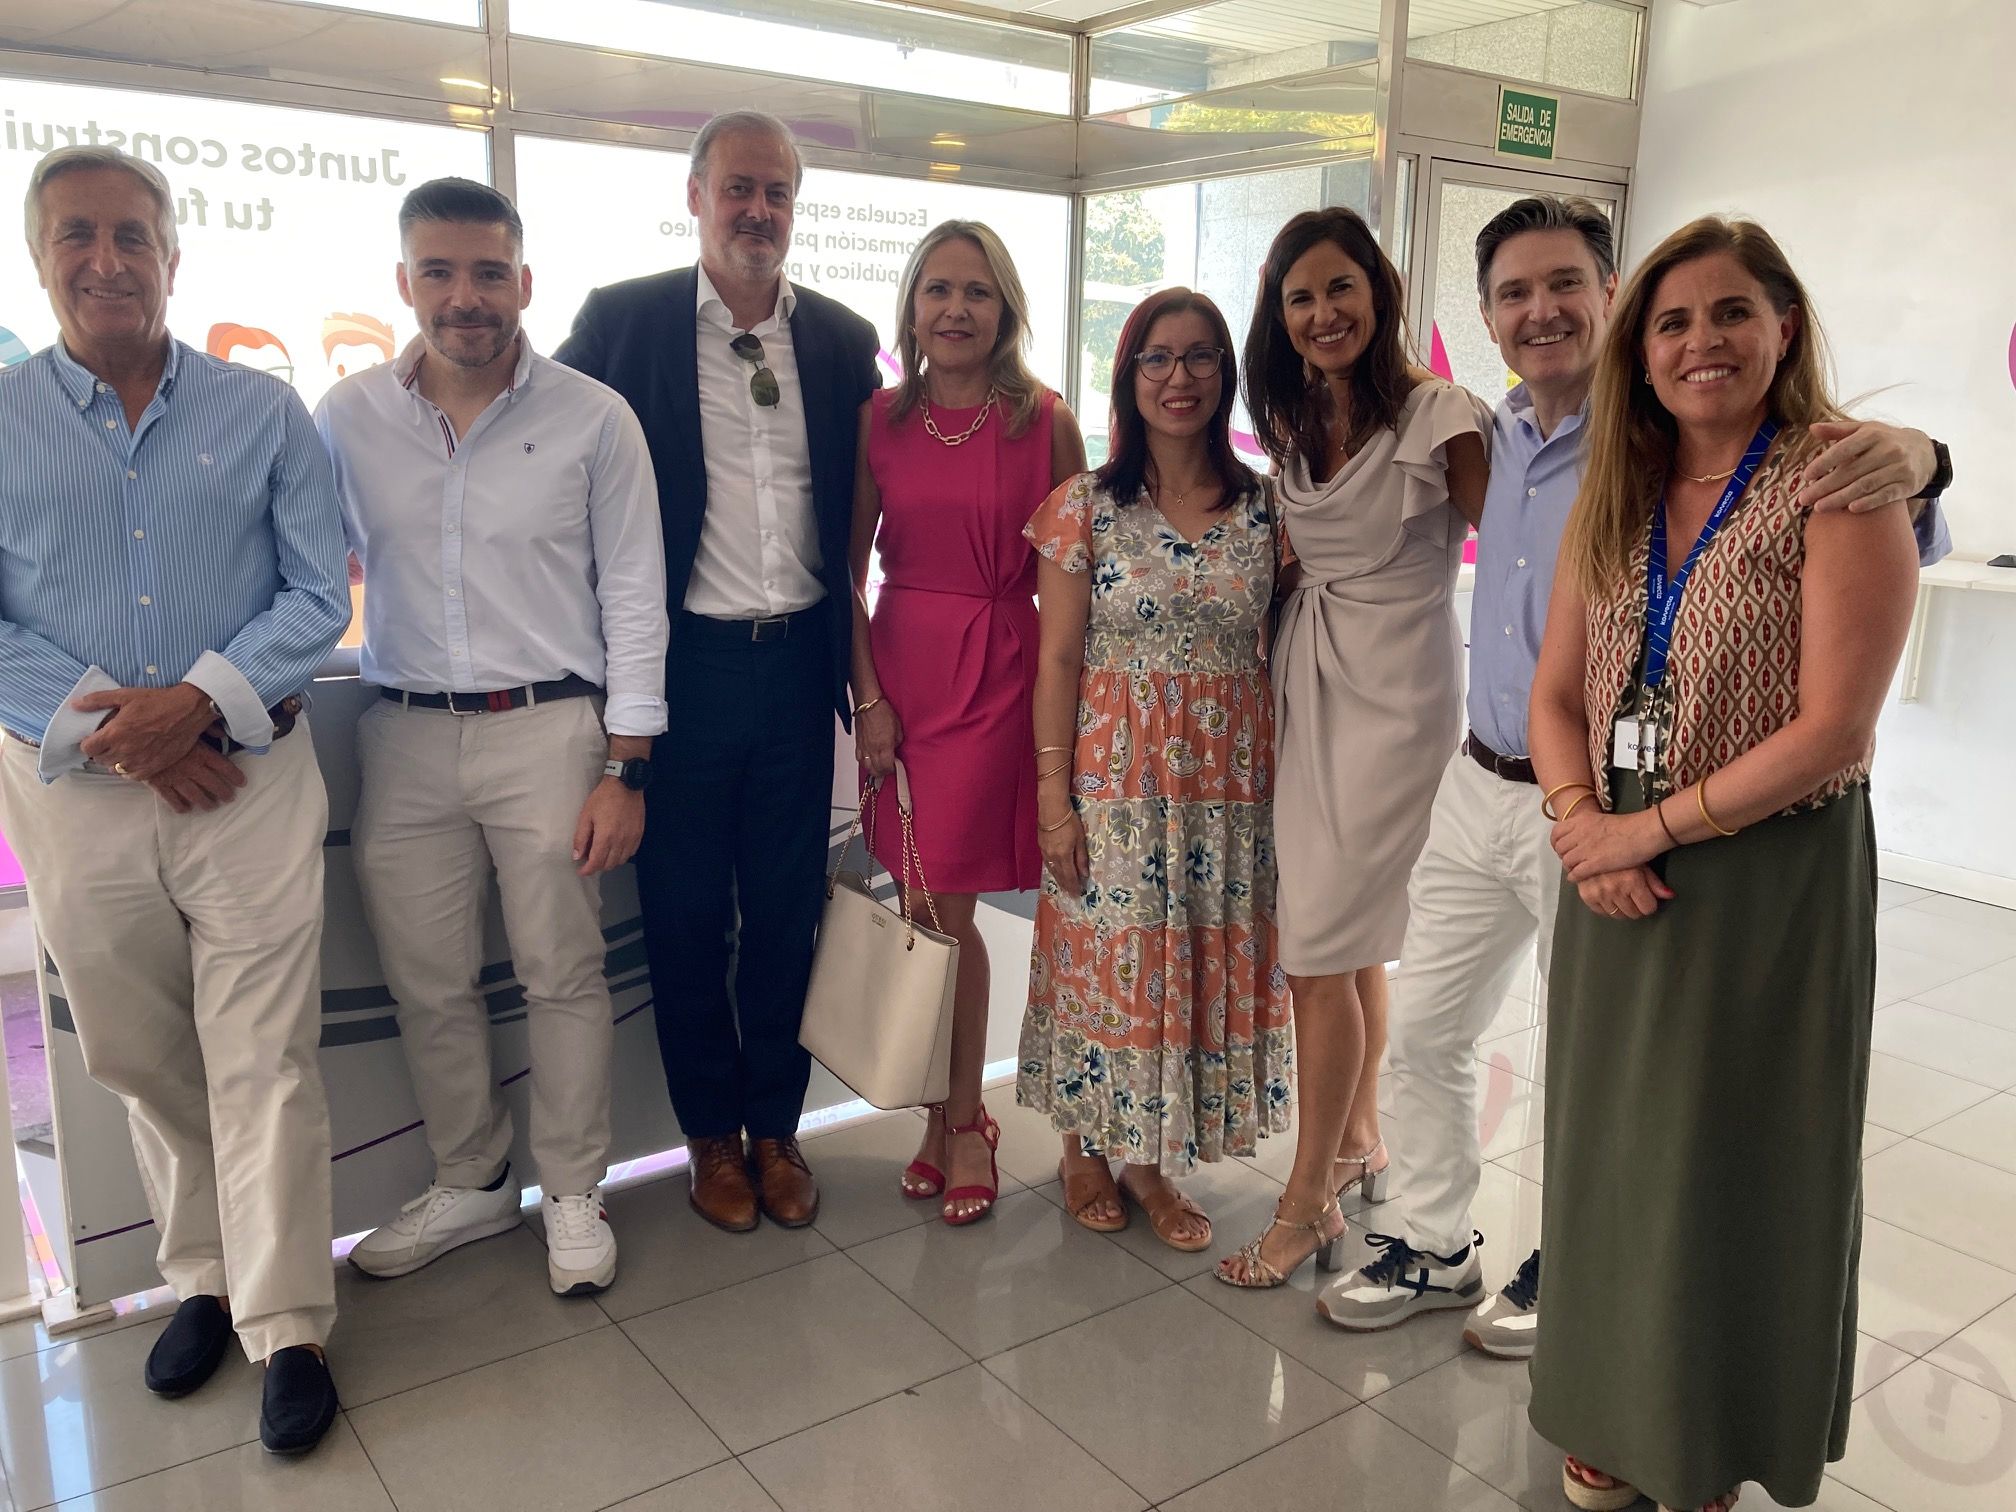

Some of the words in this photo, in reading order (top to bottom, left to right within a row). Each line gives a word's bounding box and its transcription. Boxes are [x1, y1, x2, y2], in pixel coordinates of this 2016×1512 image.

[1506, 102, 1535, 125] SALIDA
[1540, 109, 1552, 127] DE
[1500, 122, 1552, 147] EMERGENCIA
